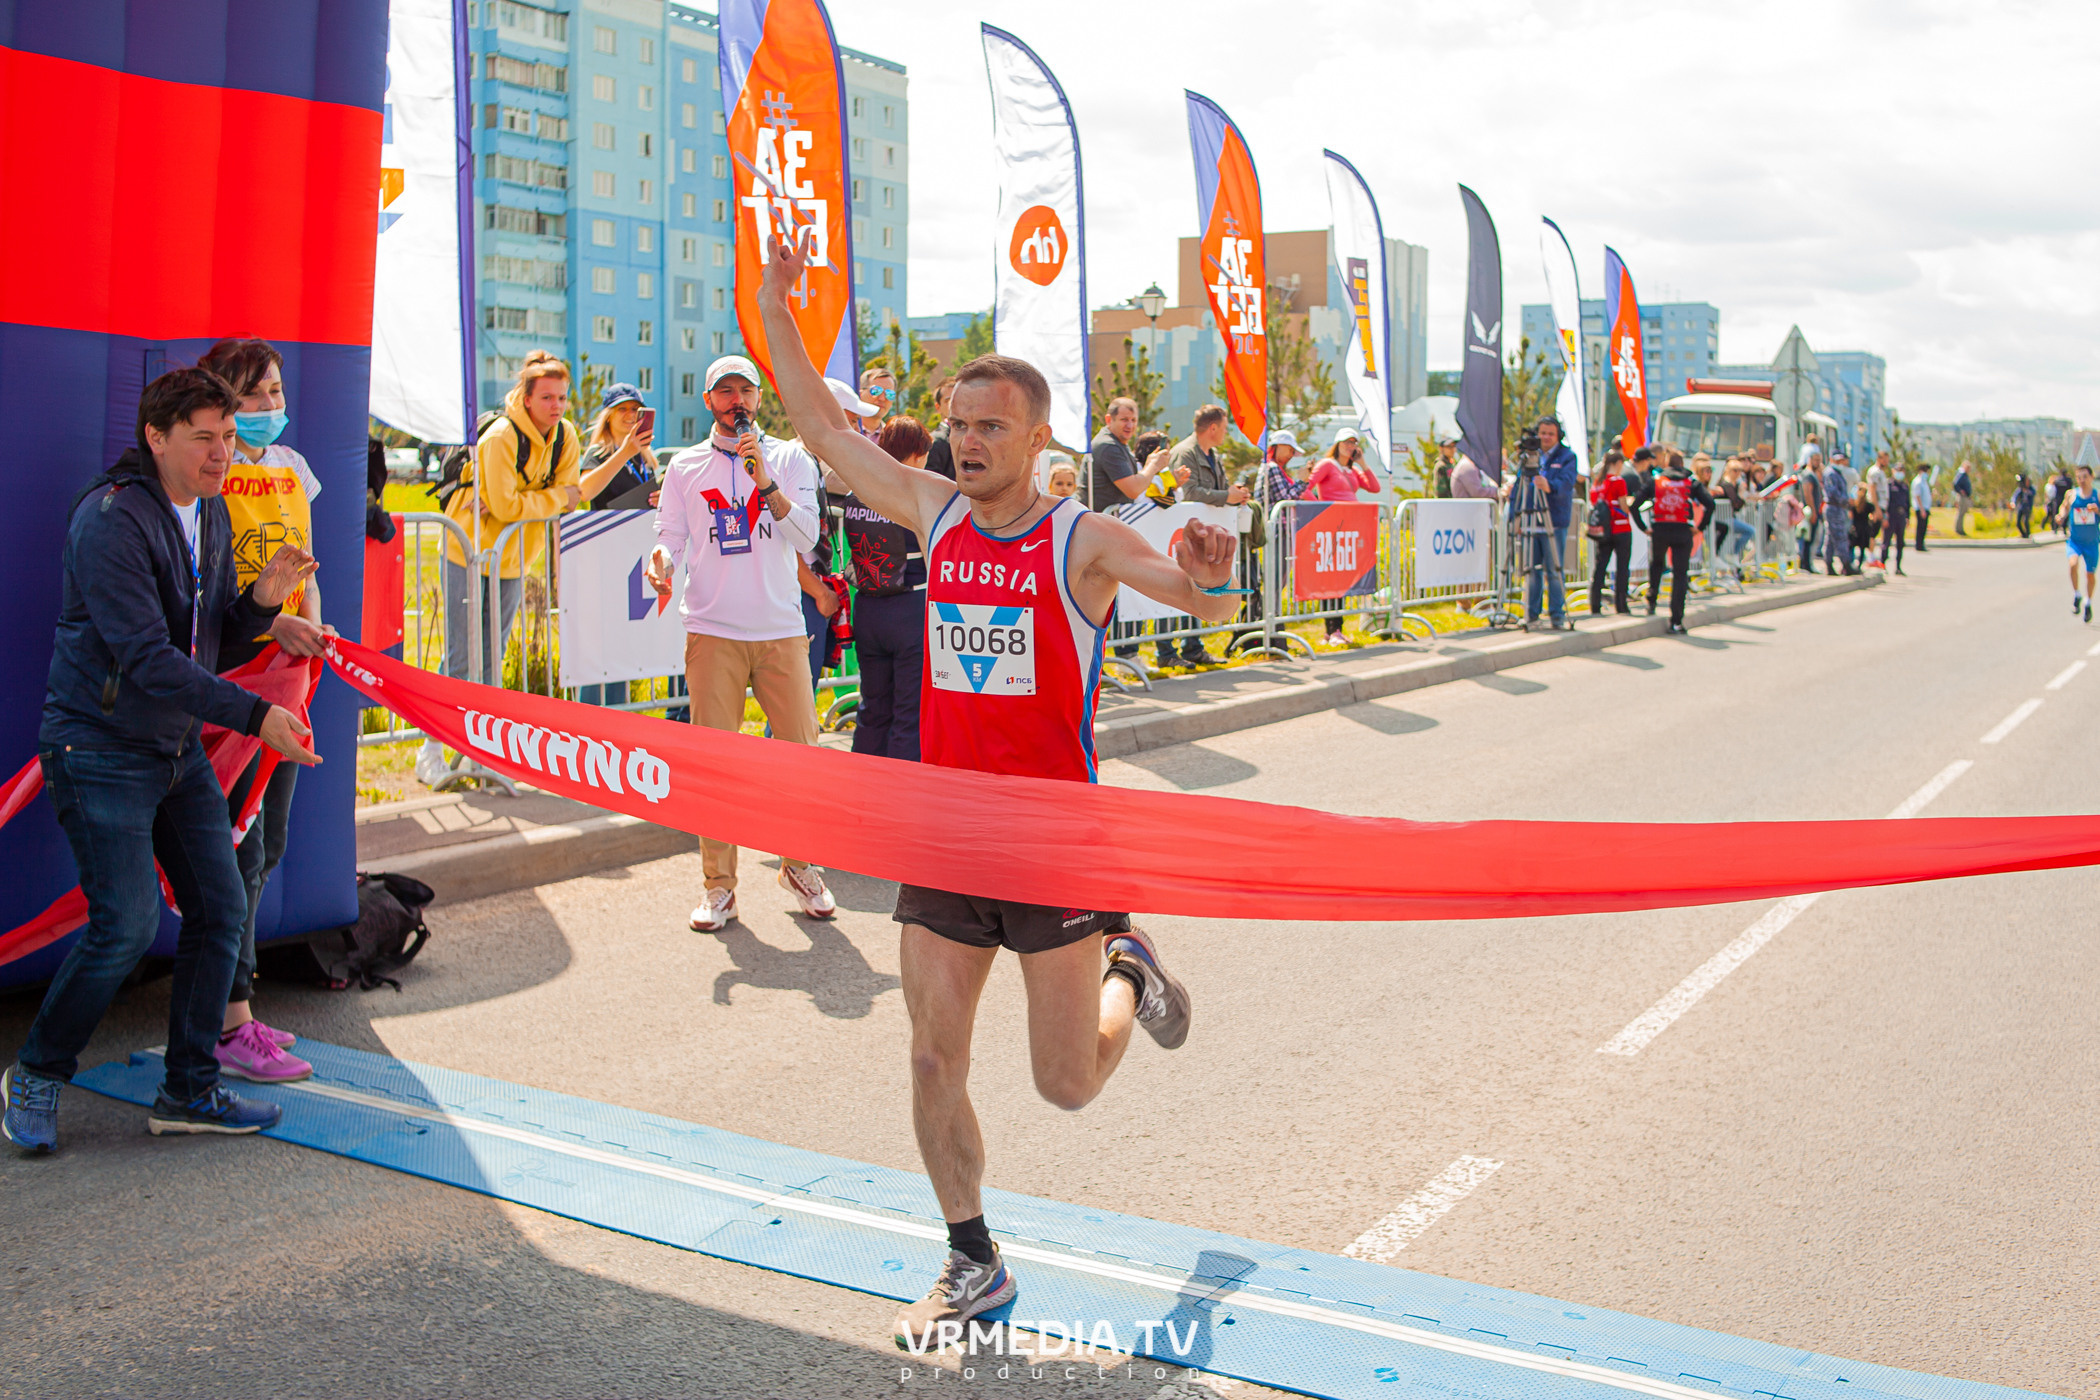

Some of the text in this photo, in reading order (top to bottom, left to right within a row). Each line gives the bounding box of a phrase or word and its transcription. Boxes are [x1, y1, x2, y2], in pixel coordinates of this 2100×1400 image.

[1433, 529, 1475, 555] OZON
[940, 561, 1038, 596] RUSSIA
[935, 624, 1027, 655] 10068
[972, 663, 982, 677] 5
